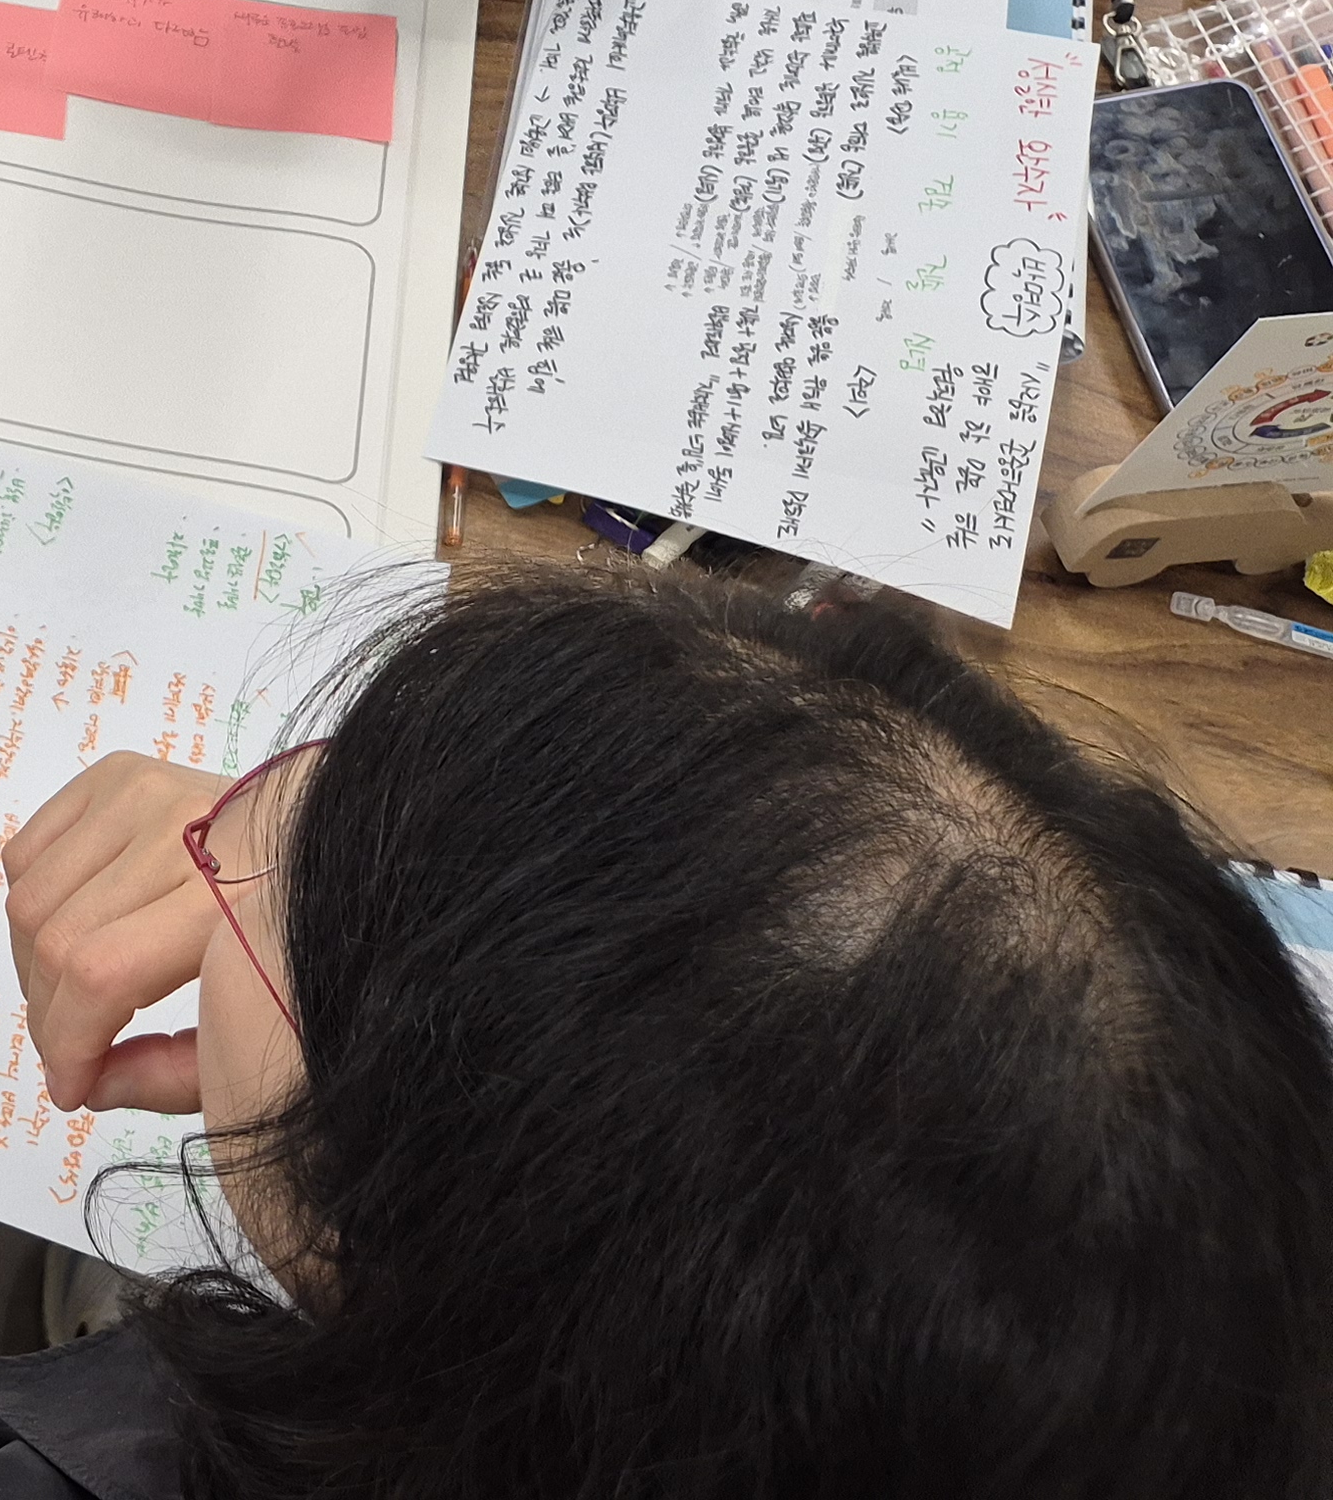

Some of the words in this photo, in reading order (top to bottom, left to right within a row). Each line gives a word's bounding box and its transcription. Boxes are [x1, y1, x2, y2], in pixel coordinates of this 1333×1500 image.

[934, 45, 972, 73] 공정
[1014, 58, 1062, 118] 성실한
[936, 109, 967, 139] 용기
[918, 175, 954, 213] 겸손
[1013, 139, 1051, 212] 완수자
[906, 255, 947, 291] 진솔
[1002, 257, 1045, 325] 박명수
[899, 332, 935, 372] 신념
[972, 363, 998, 406] 해야
[959, 420, 991, 443] 할
[989, 439, 1036, 549] 존중하면서도
